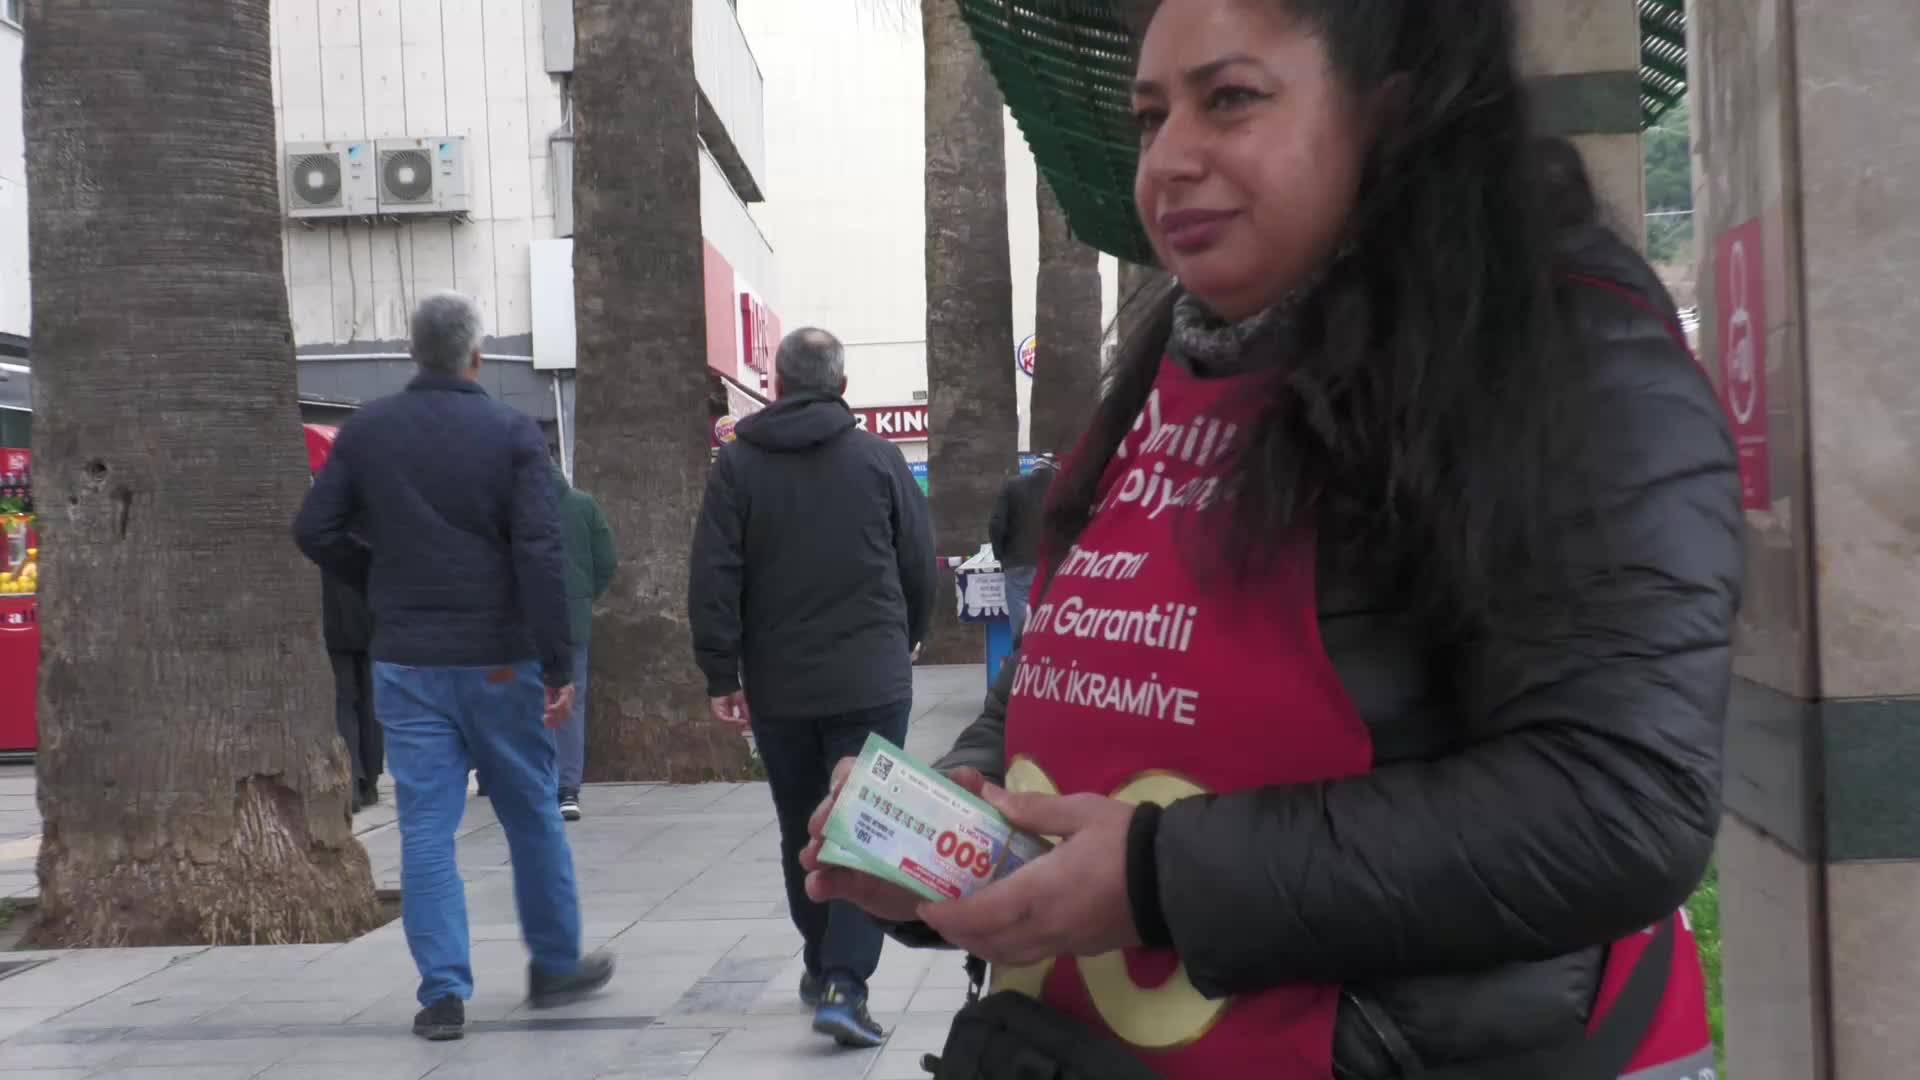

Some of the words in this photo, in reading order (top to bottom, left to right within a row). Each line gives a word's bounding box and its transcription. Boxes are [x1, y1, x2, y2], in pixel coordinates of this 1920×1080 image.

[1053, 595, 1198, 653] Garantili
[1011, 655, 1066, 703] ÜYÜK
[1064, 659, 1200, 726] İKRAMİYE
[935, 830, 992, 879] 600
